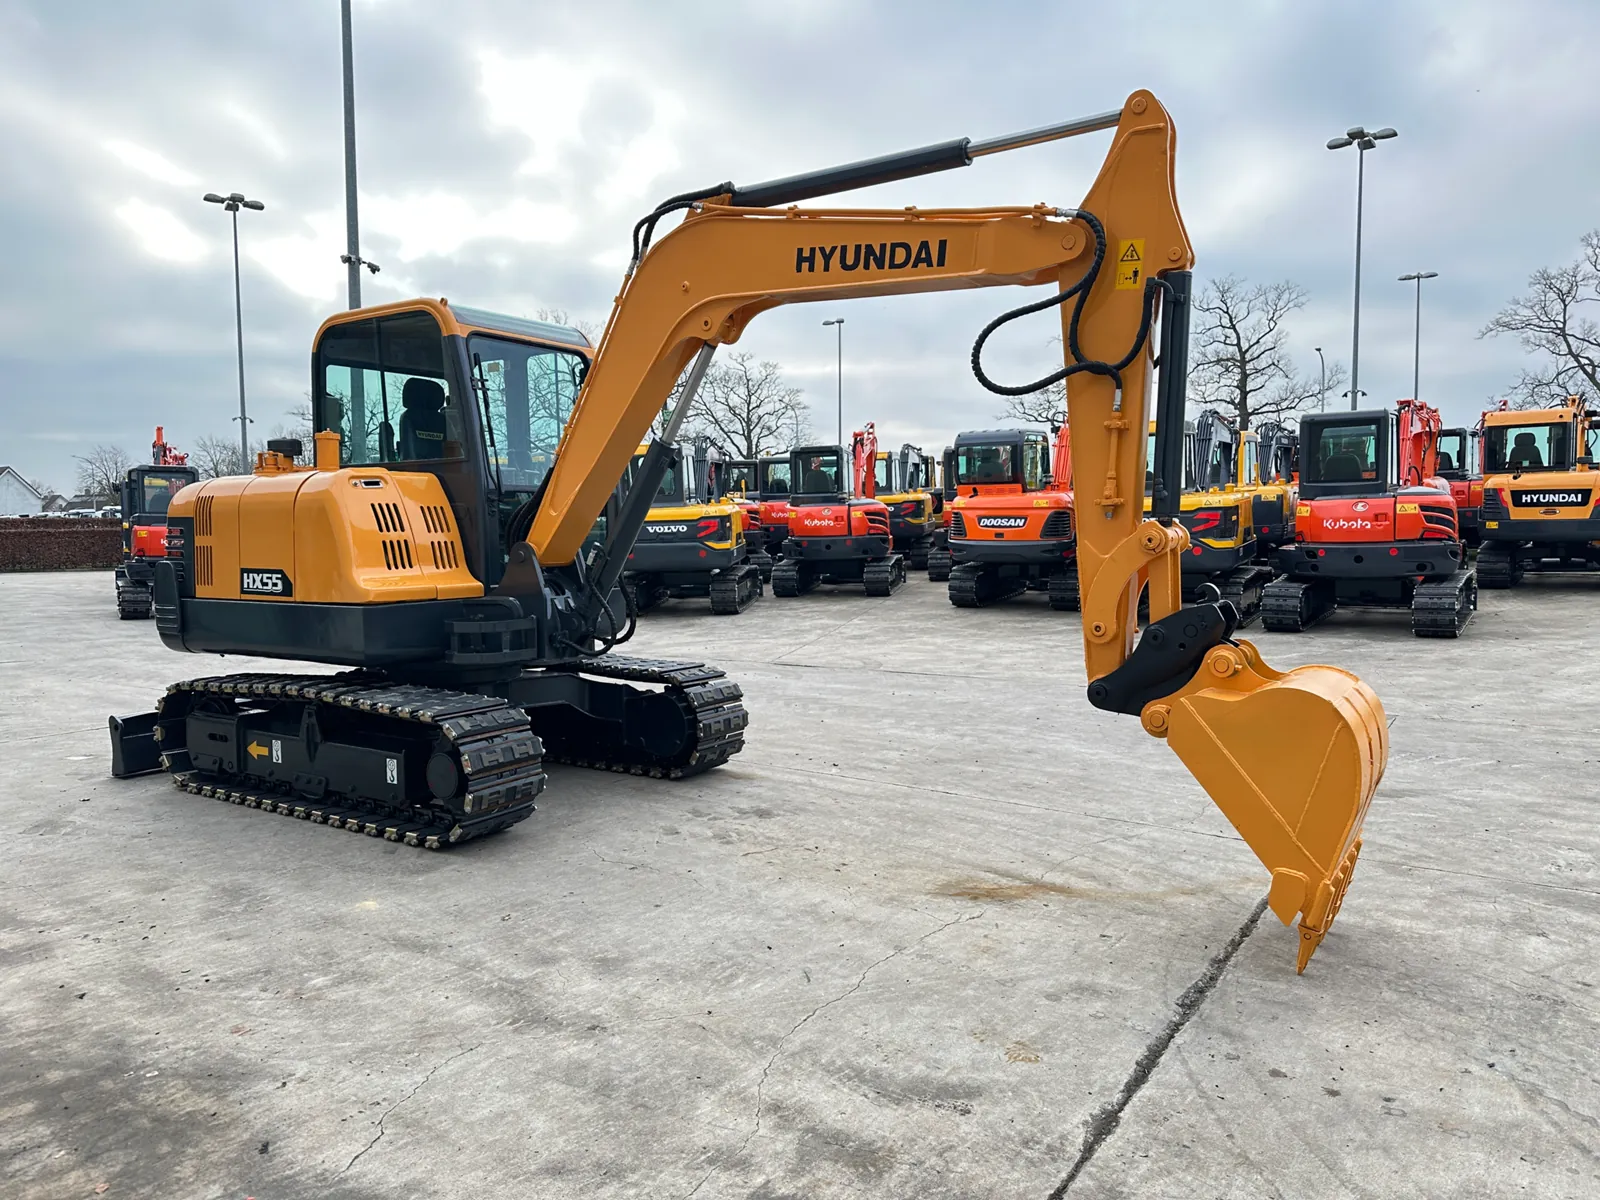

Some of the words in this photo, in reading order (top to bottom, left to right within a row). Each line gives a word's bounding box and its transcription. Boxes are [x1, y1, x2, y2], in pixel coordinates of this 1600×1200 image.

[795, 239, 948, 273] HYUNDAI
[1521, 493, 1582, 503] HYUNDAI
[980, 518, 1025, 527] DOOSAN
[1323, 518, 1371, 529] Kubota
[646, 525, 687, 533] VOLVO
[243, 573, 283, 592] HX55
